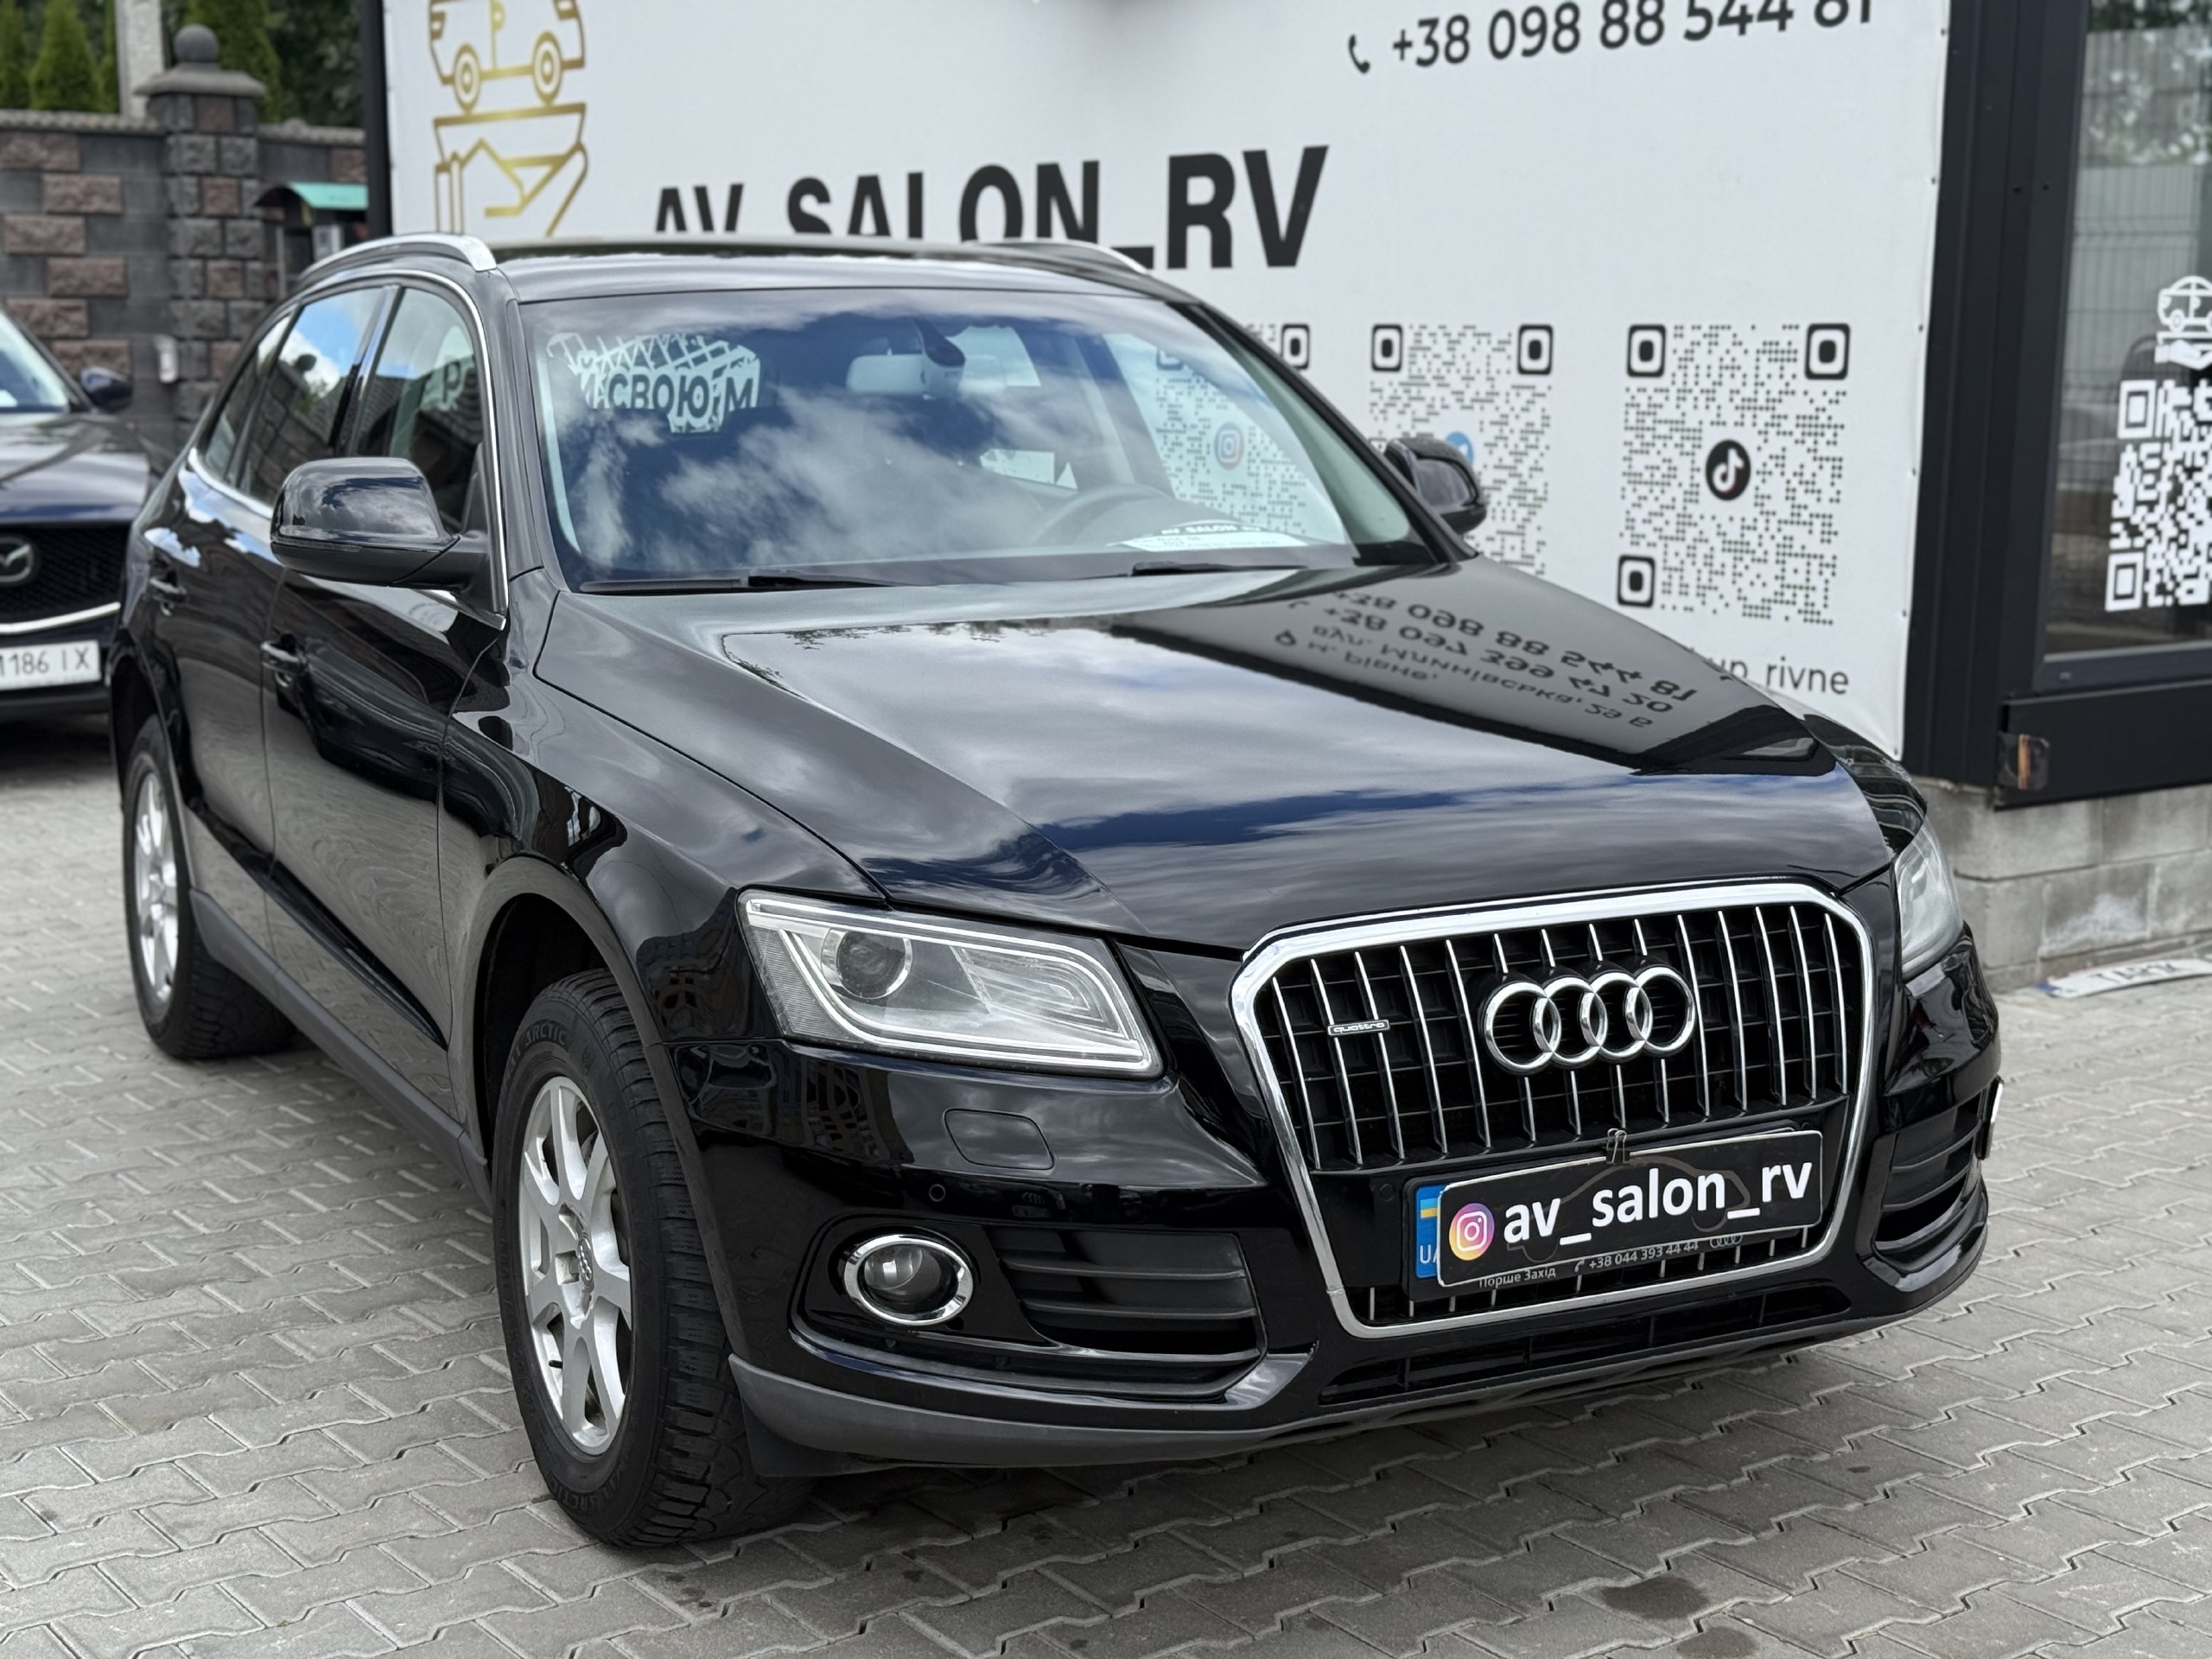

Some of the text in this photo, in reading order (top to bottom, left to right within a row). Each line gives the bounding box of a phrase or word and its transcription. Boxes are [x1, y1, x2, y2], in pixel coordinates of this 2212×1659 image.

[1392, 14, 1471, 67] +38
[1488, 1, 1580, 60] 098
[1599, 0, 1664, 49] 88
[61, 647, 90, 671] IX
[1332, 1022, 1385, 1034] quattro
[1503, 1161, 1813, 1246] av_salon_rv
[1589, 1241, 1698, 1269] +38 044 393 44 44
[1523, 1267, 1557, 1282] Захід
